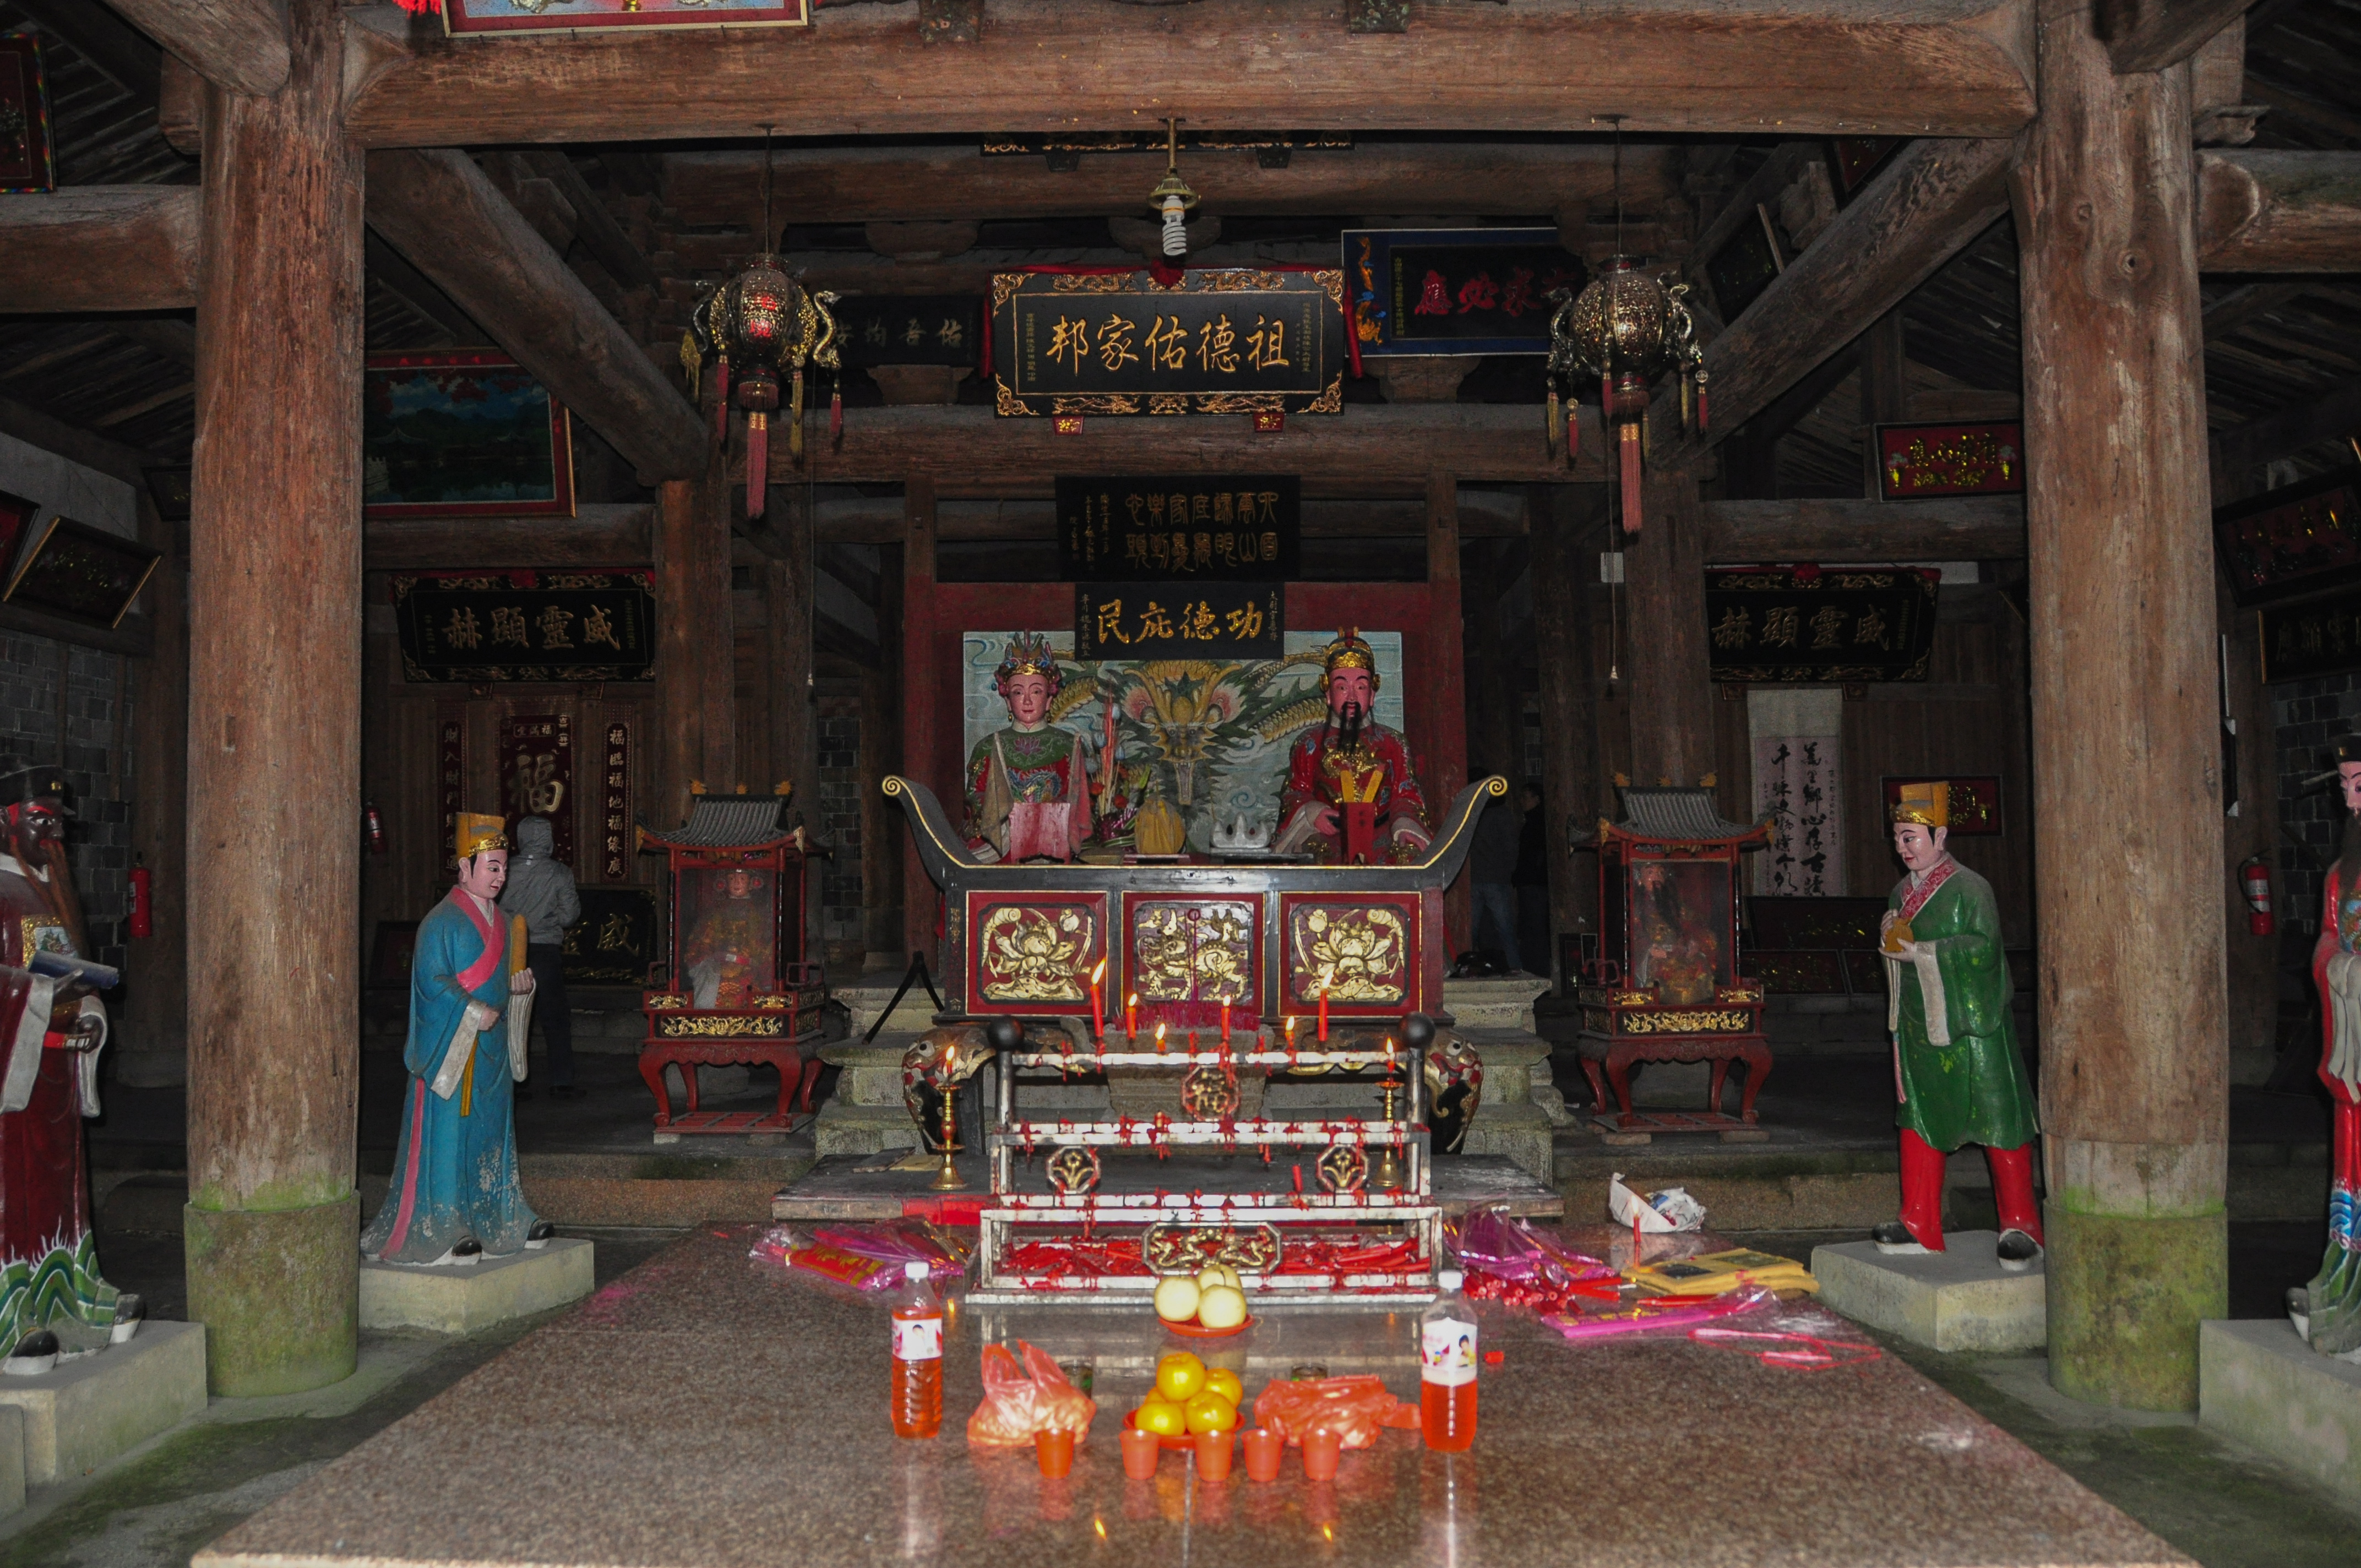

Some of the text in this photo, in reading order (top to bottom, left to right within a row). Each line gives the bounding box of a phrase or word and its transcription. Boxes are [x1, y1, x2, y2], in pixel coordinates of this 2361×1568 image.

[1046, 313, 1290, 376] 祖德佑家邦
[440, 603, 622, 651] 威靈顯赫
[1097, 598, 1264, 645] 功德庇民
[1711, 603, 1890, 652] 威靈顯赫
[506, 753, 565, 815] 福
[607, 729, 625, 875] 福臨福地福緣廣
